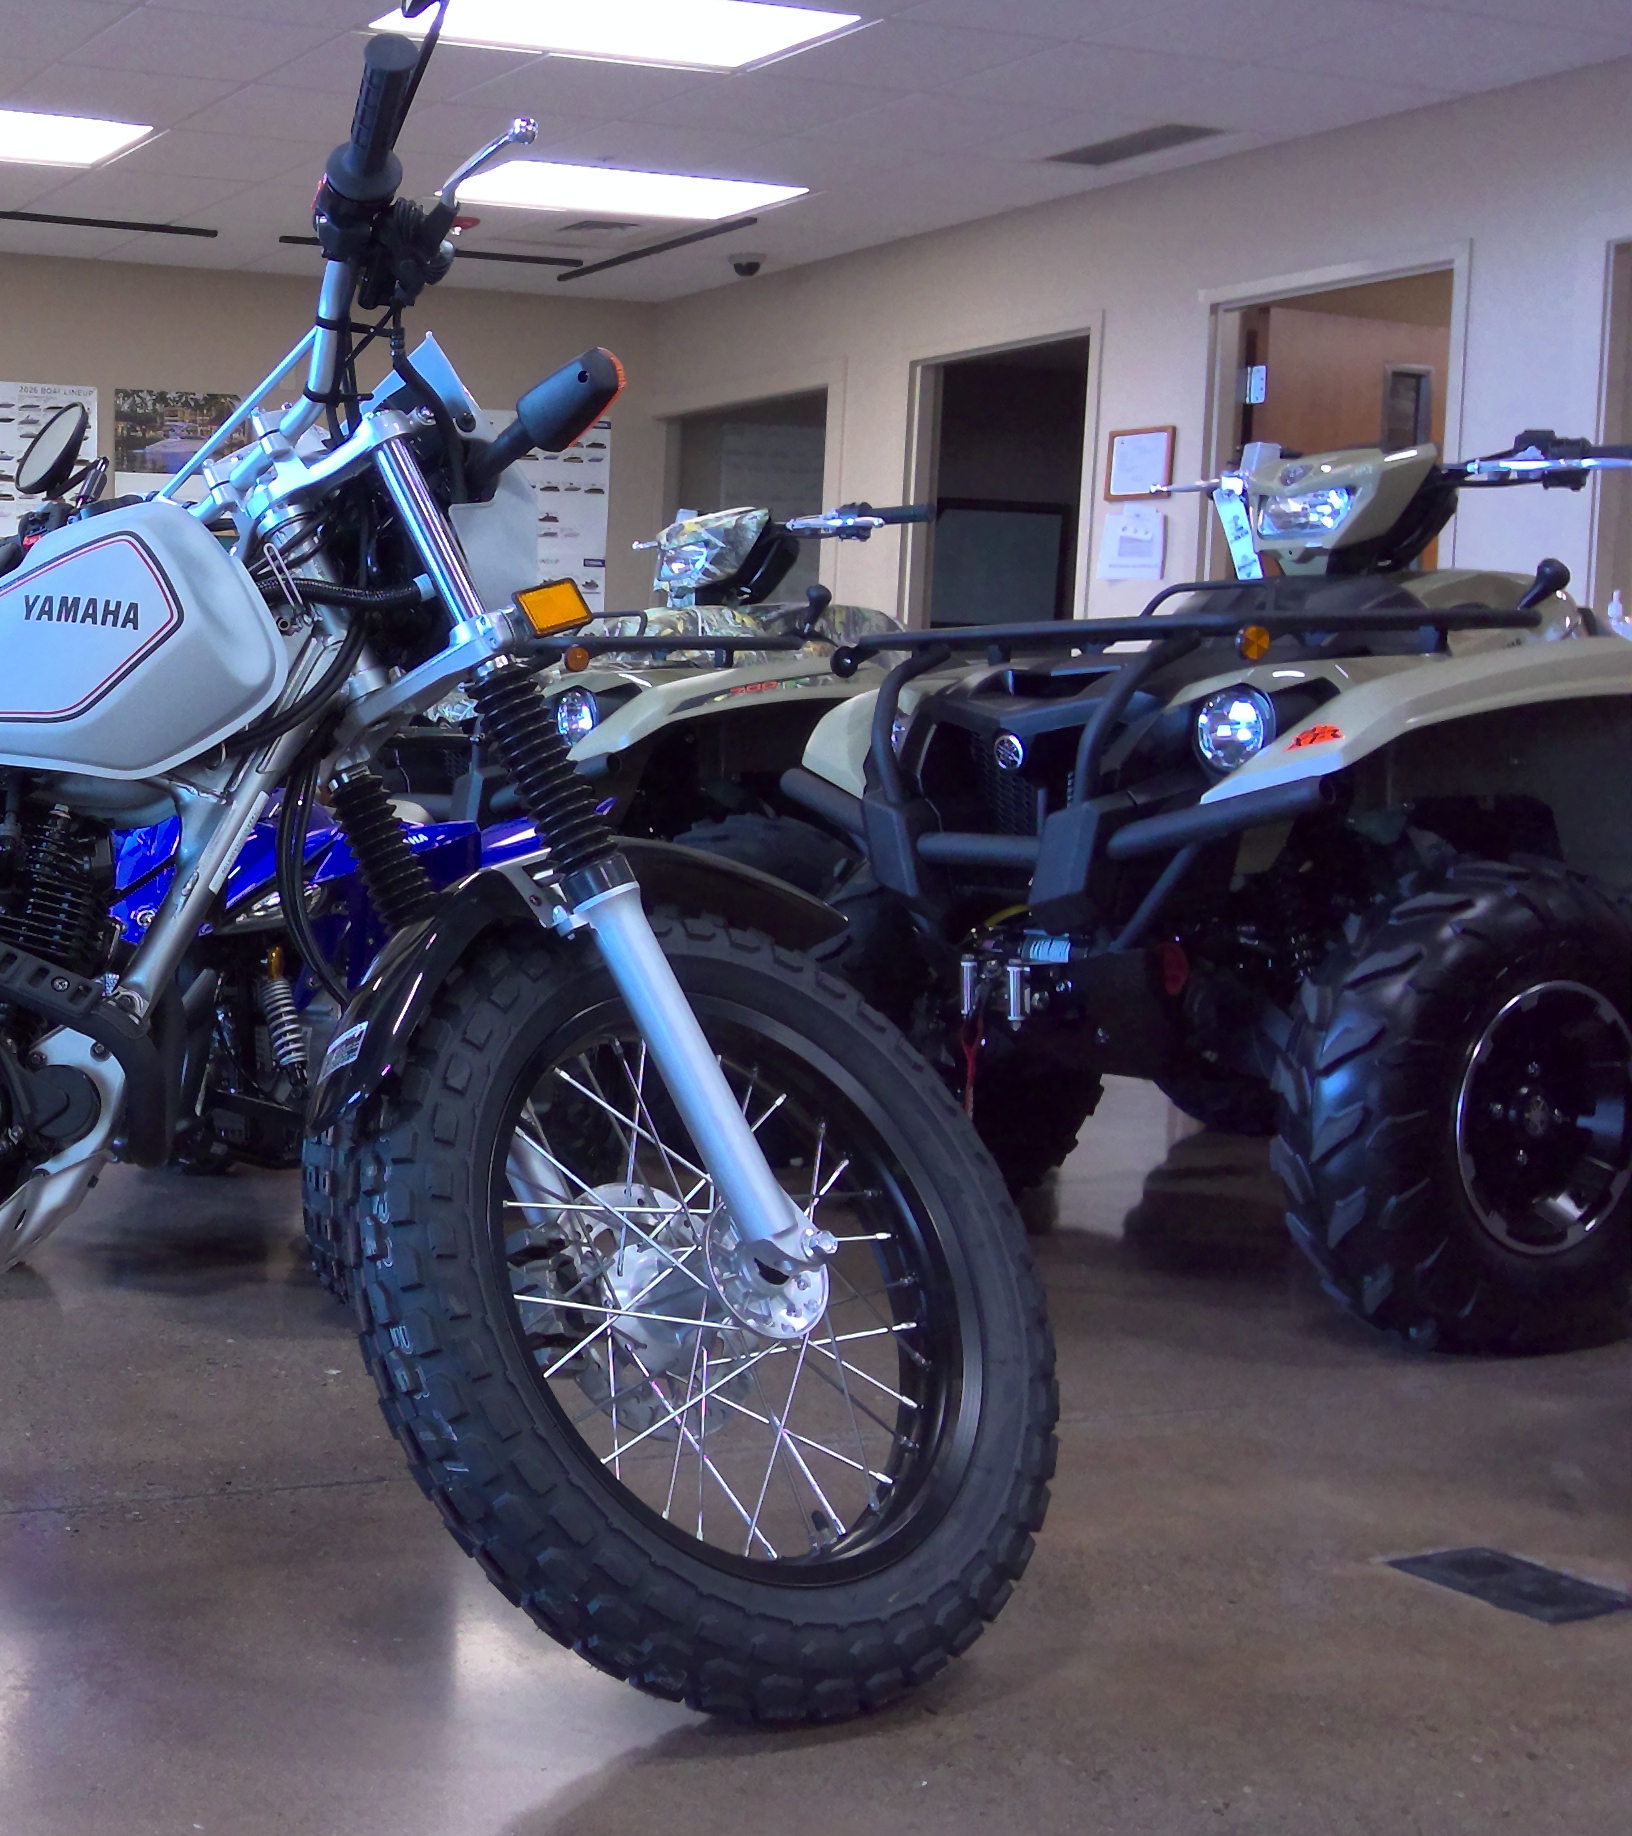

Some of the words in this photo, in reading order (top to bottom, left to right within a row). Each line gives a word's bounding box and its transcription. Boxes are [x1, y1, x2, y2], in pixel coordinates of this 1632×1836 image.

[19, 386, 38, 394] 2026
[41, 387, 60, 395] BOAT
[64, 389, 94, 397] LINEUP
[24, 594, 139, 631] YAMAHA
